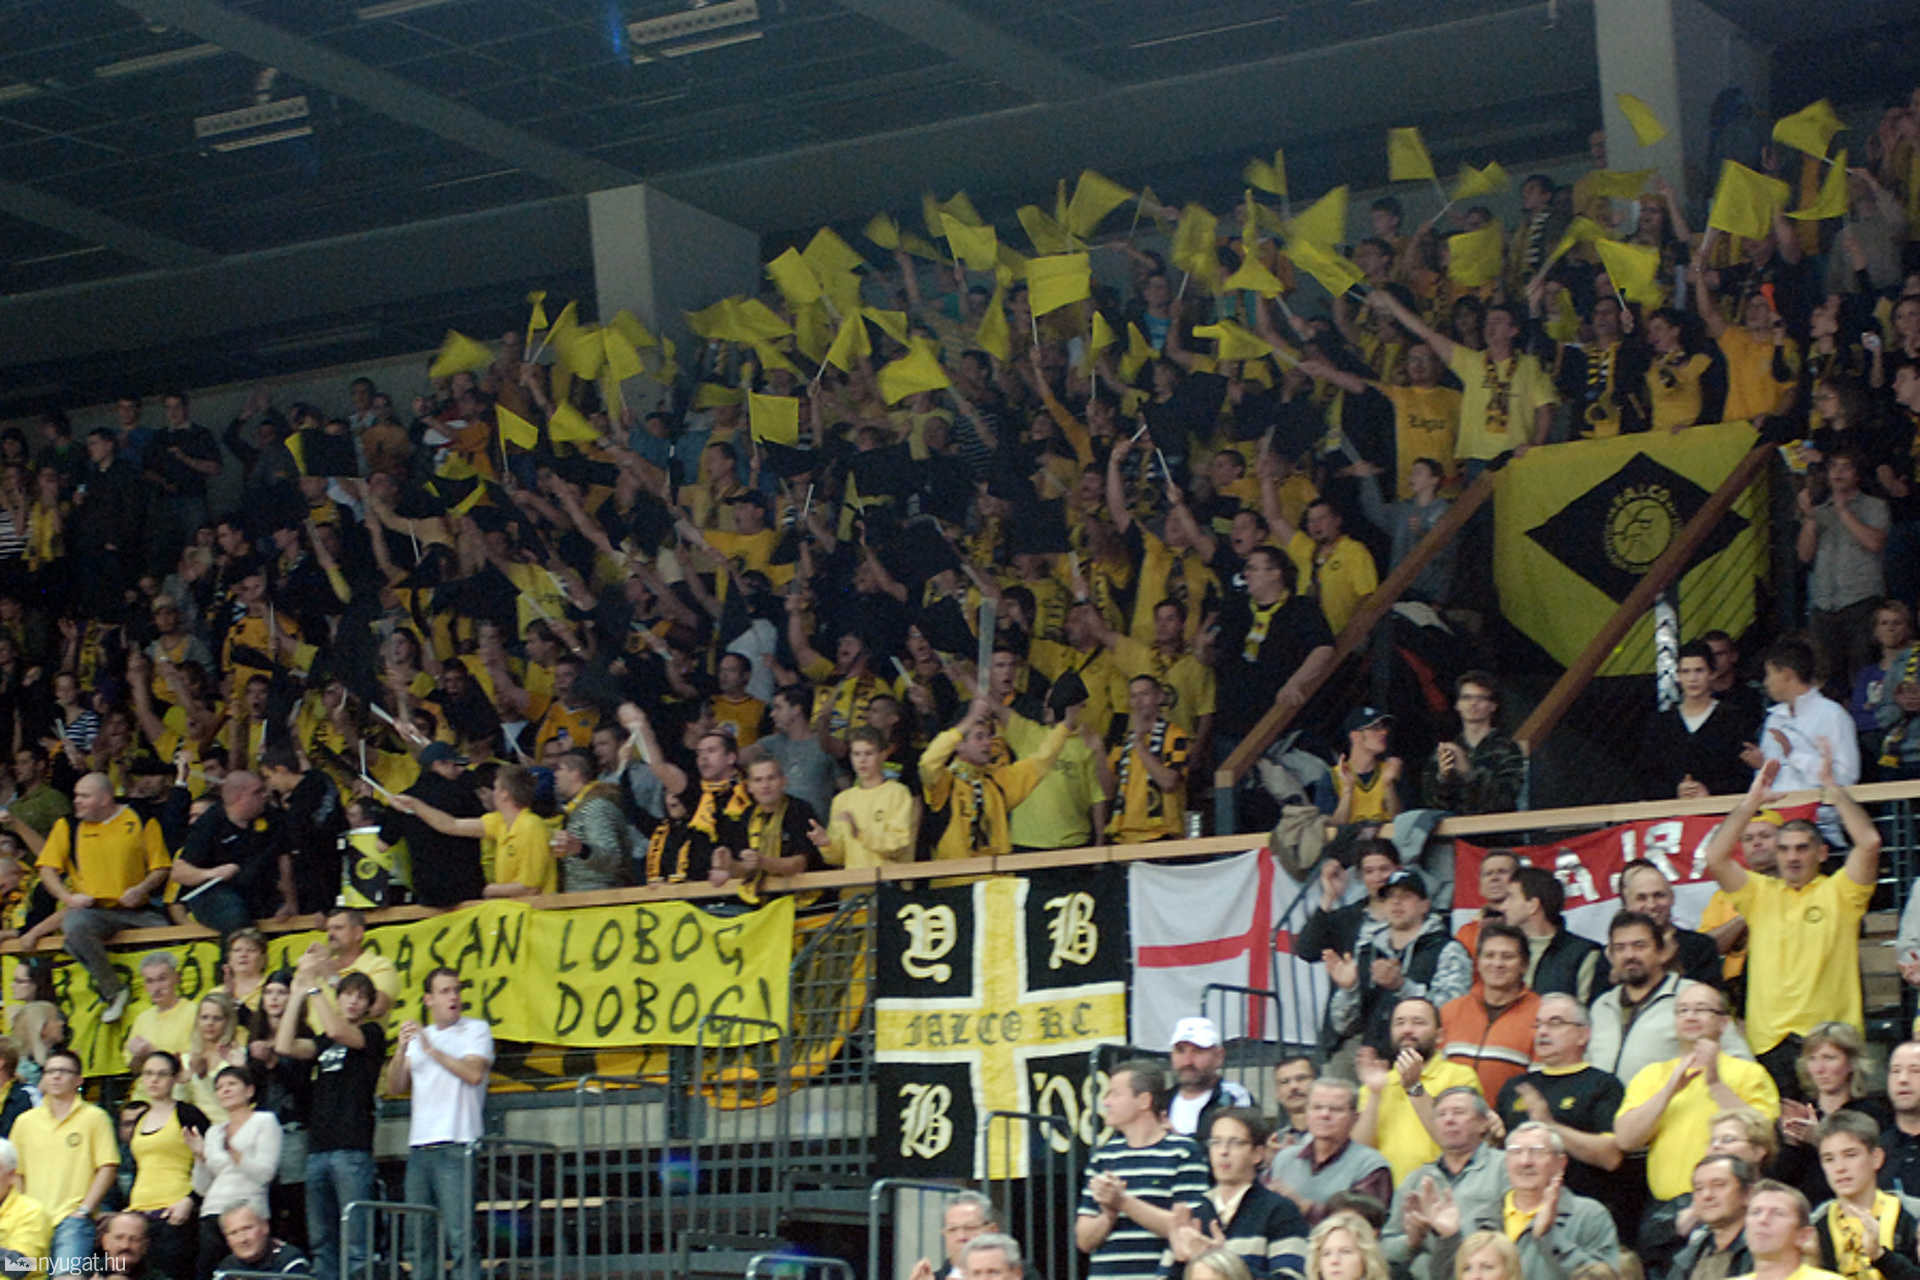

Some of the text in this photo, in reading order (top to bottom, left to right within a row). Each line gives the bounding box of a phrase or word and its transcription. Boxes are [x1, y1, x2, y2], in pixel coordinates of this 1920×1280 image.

[558, 907, 744, 975] LOBOG
[1043, 892, 1099, 969] B
[899, 1082, 953, 1159] B
